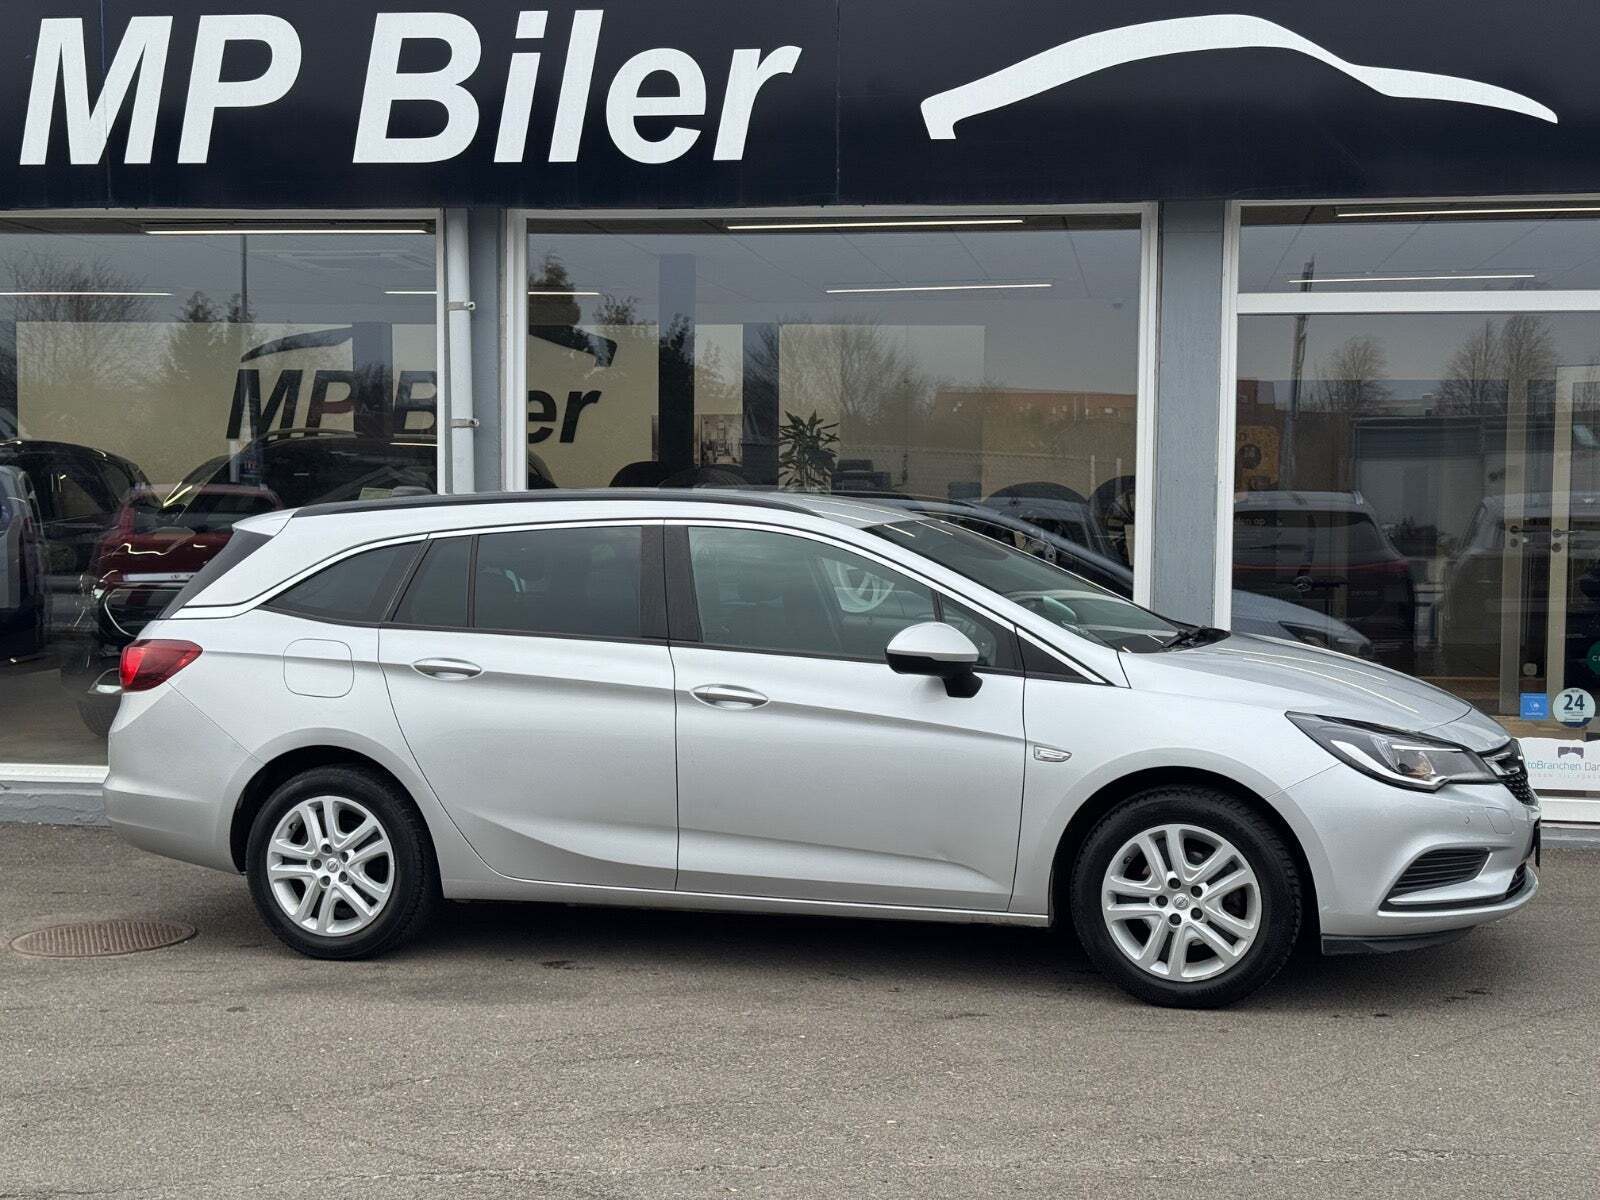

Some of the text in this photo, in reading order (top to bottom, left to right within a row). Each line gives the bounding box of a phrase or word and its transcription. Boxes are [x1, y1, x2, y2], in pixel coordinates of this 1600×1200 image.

[20, 10, 802, 165] MP Biler
[226, 369, 362, 440] MP
[1563, 694, 1585, 711] 24
[1528, 760, 1581, 770] toBranchen
